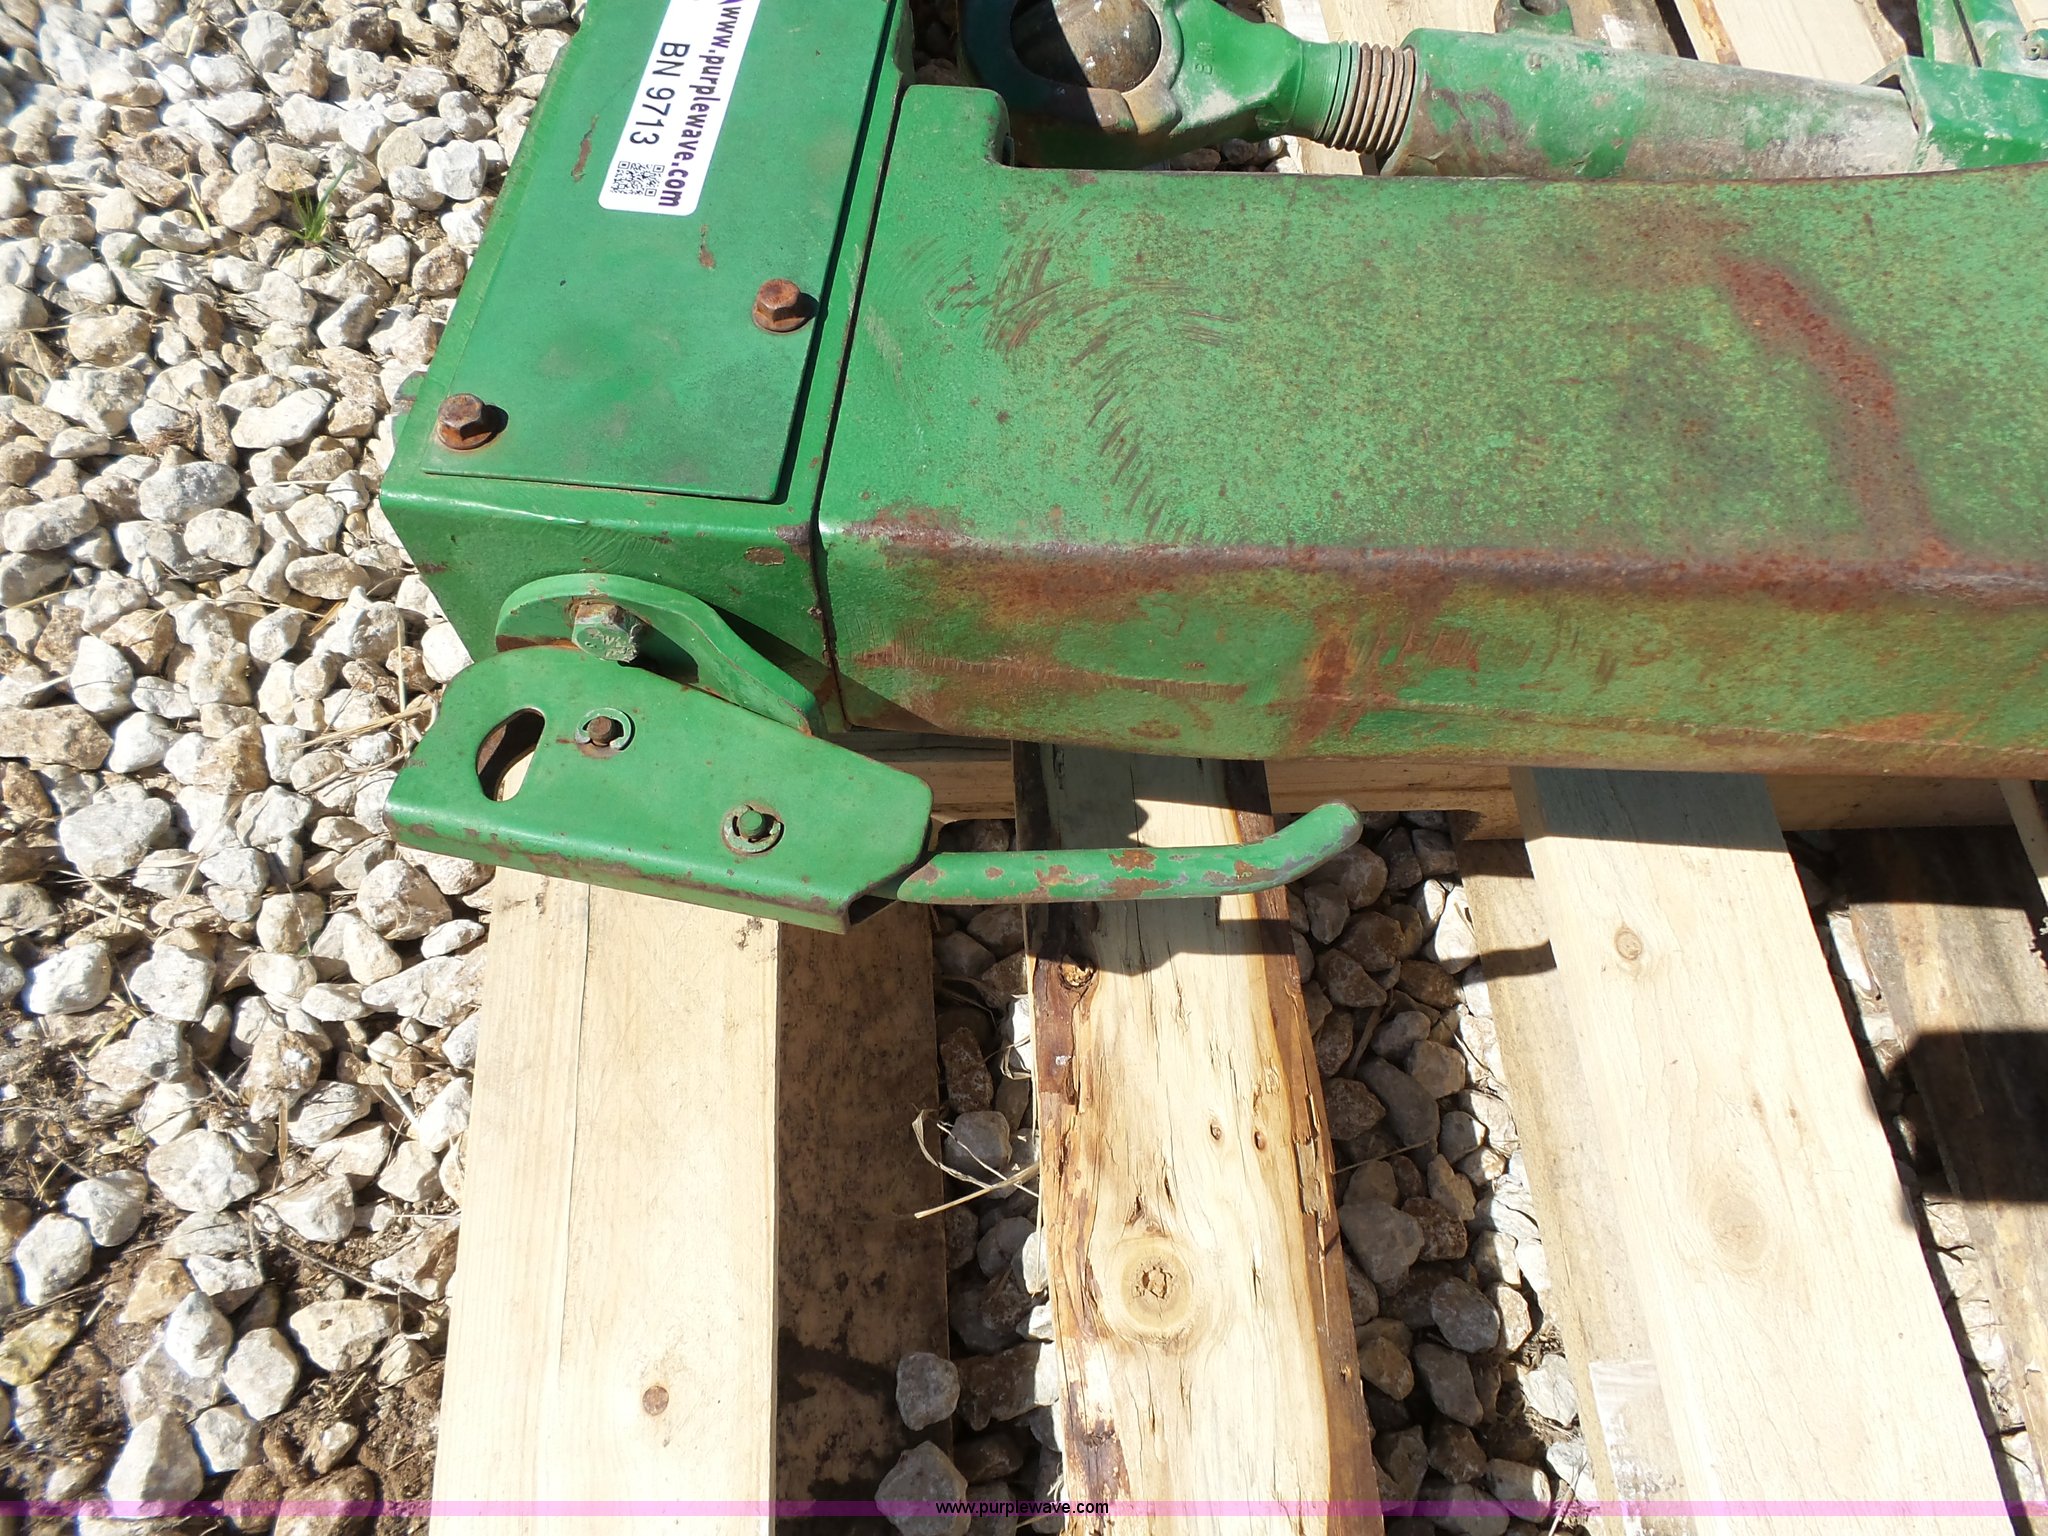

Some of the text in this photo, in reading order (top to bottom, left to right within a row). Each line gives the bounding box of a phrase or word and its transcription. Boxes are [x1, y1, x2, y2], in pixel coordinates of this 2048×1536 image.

[629, 42, 691, 145] BN 9713
[658, 6, 742, 207] www.purplewave.com
